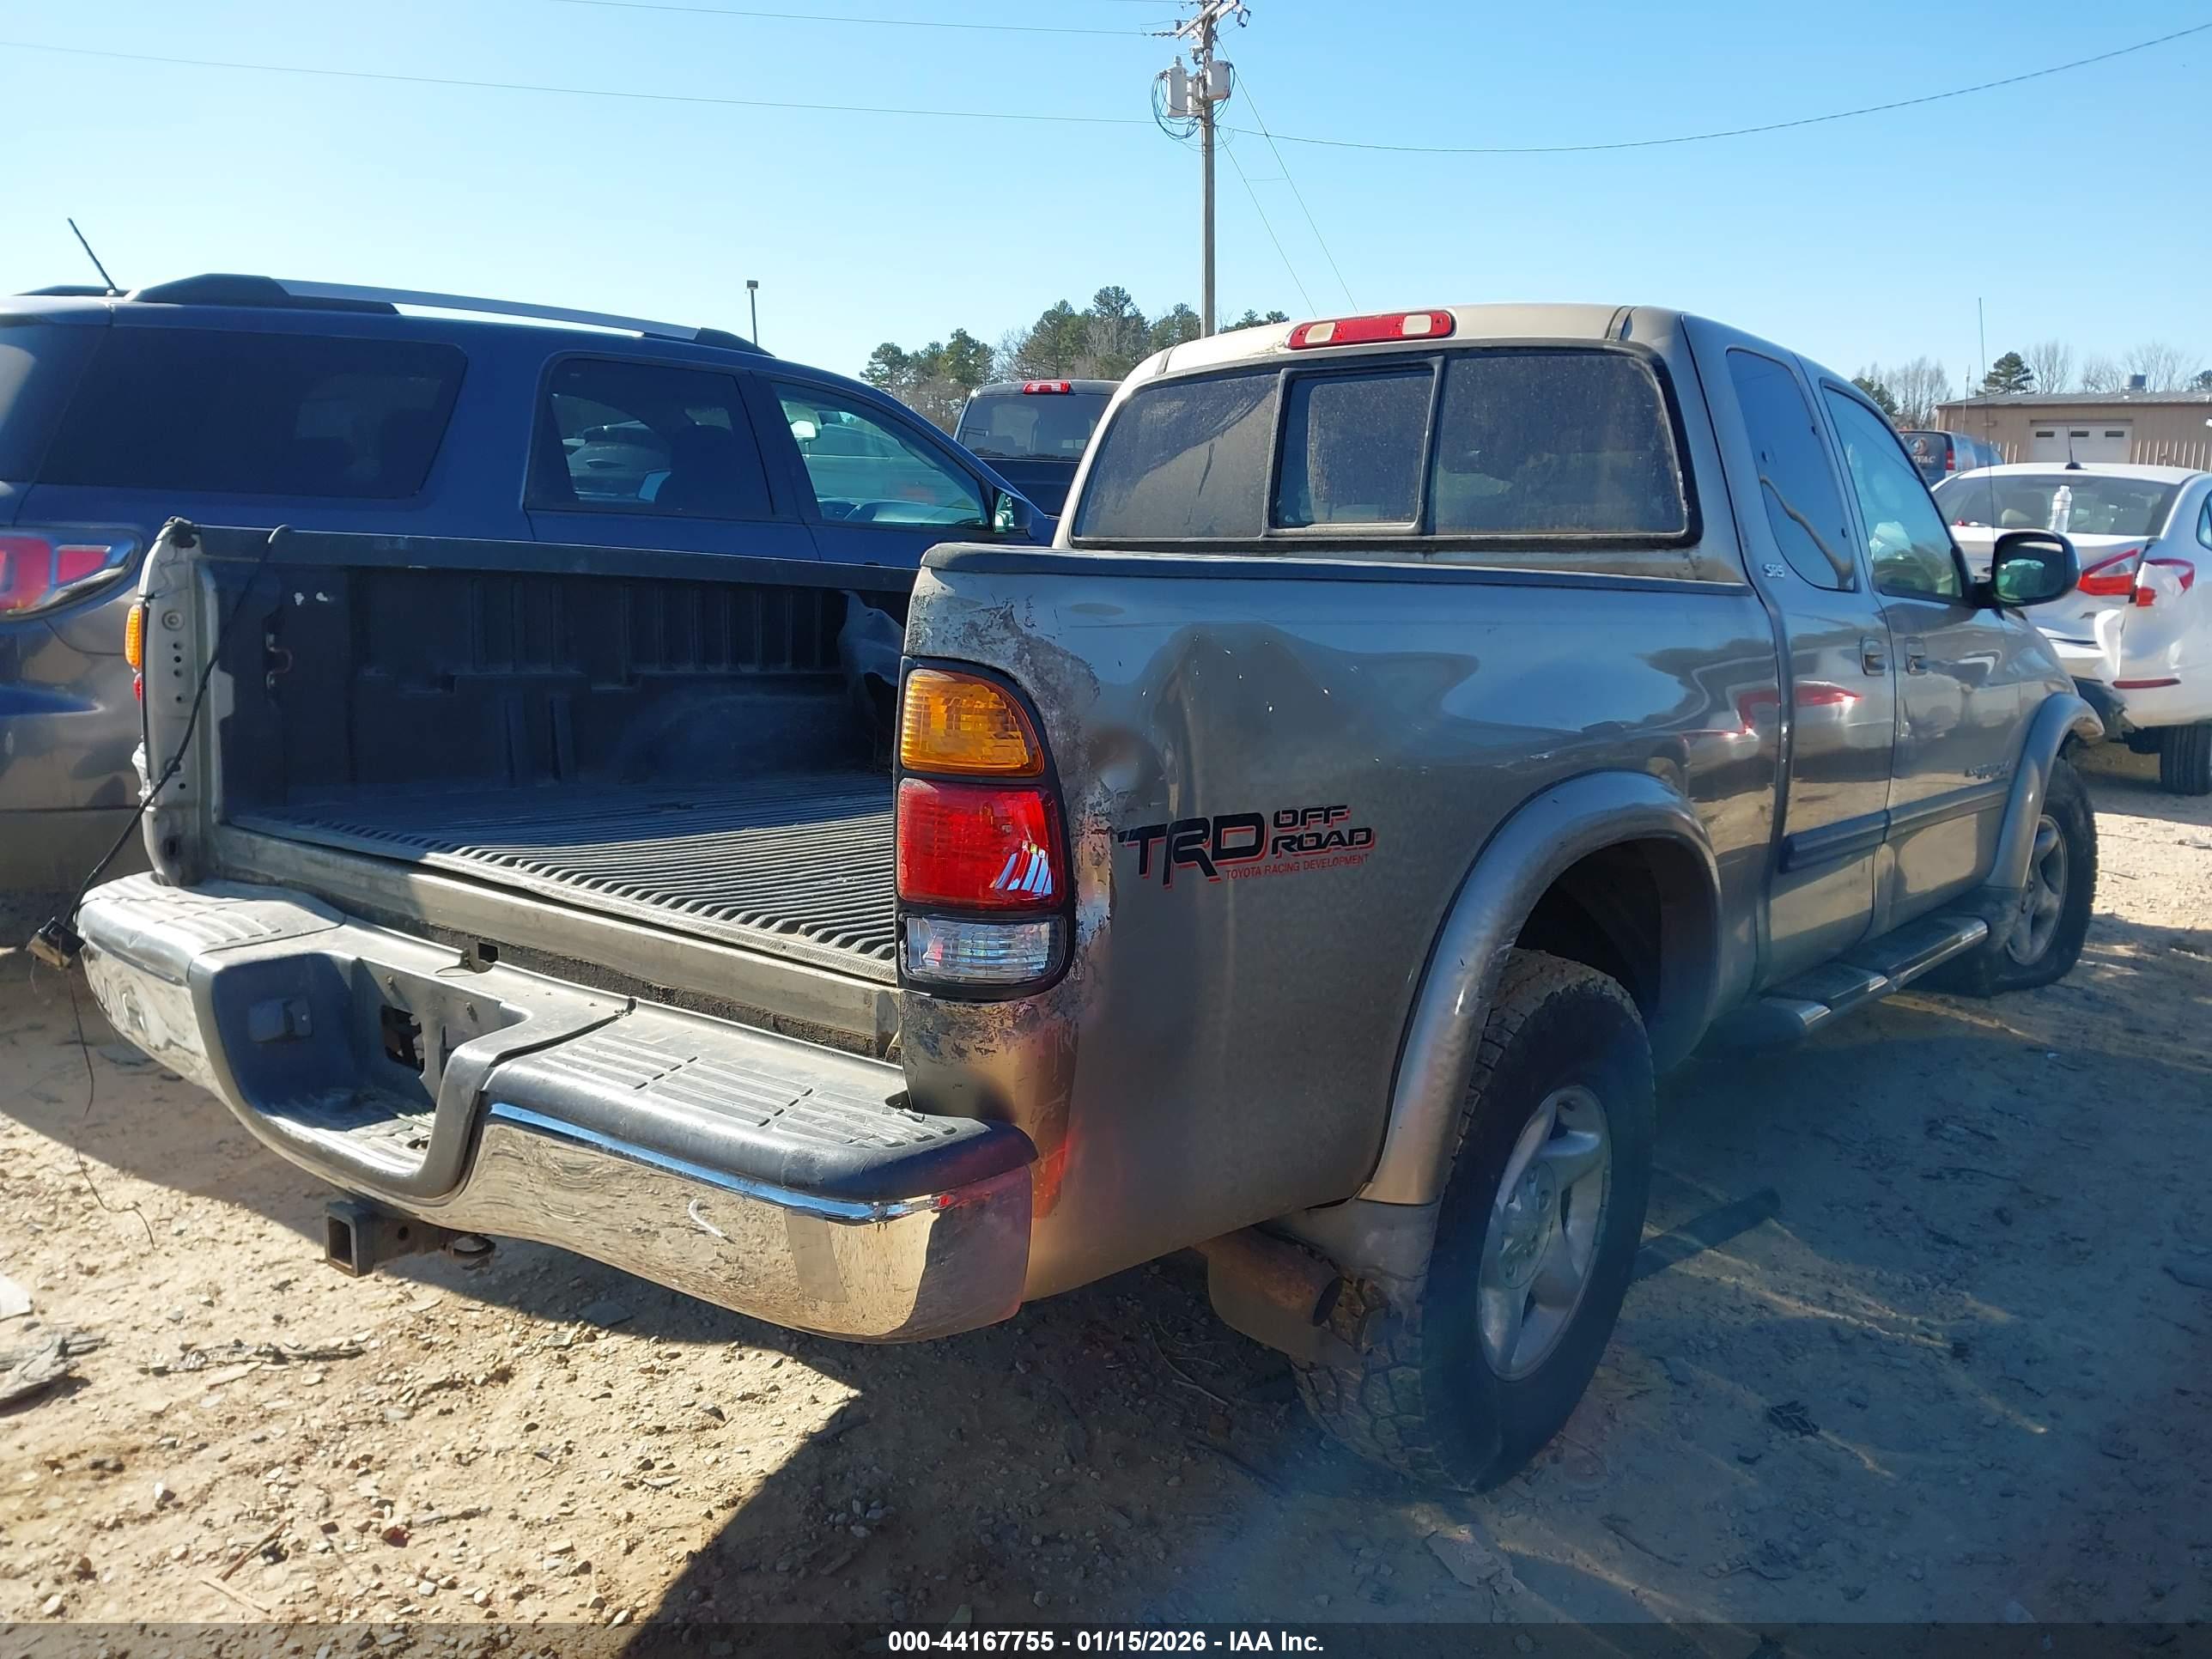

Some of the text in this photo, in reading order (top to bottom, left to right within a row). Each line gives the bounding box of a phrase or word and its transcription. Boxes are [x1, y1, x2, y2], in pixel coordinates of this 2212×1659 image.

[1273, 805, 1351, 832] OFF
[1118, 812, 1269, 888] TRD
[1271, 827, 1376, 859] ROAD
[1225, 854, 1370, 880] TOYOTA RACING DEVELOPMENT
